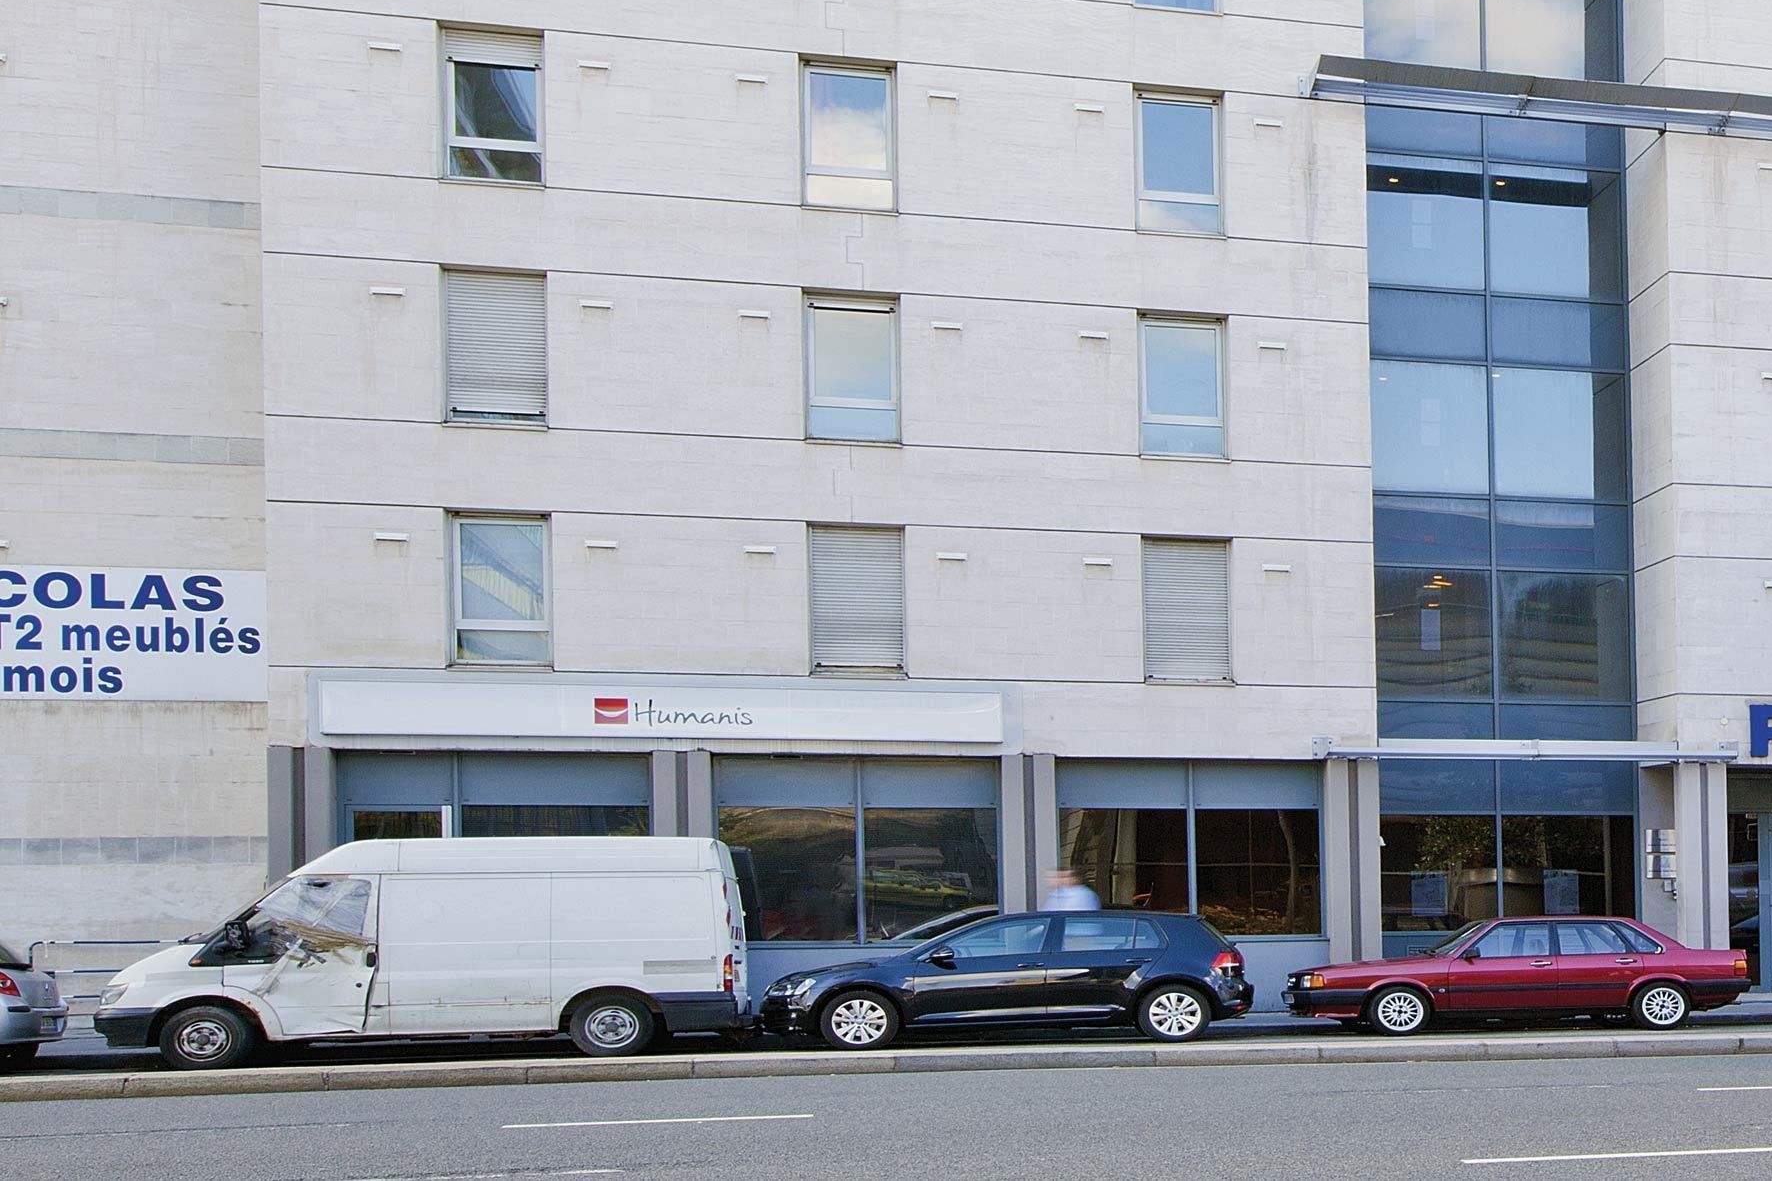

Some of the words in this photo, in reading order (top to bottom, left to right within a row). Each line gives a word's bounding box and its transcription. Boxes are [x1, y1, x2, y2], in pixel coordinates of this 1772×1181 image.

[61, 616, 260, 653] meublés
[3, 656, 123, 694] mois
[634, 698, 753, 727] Humanis
